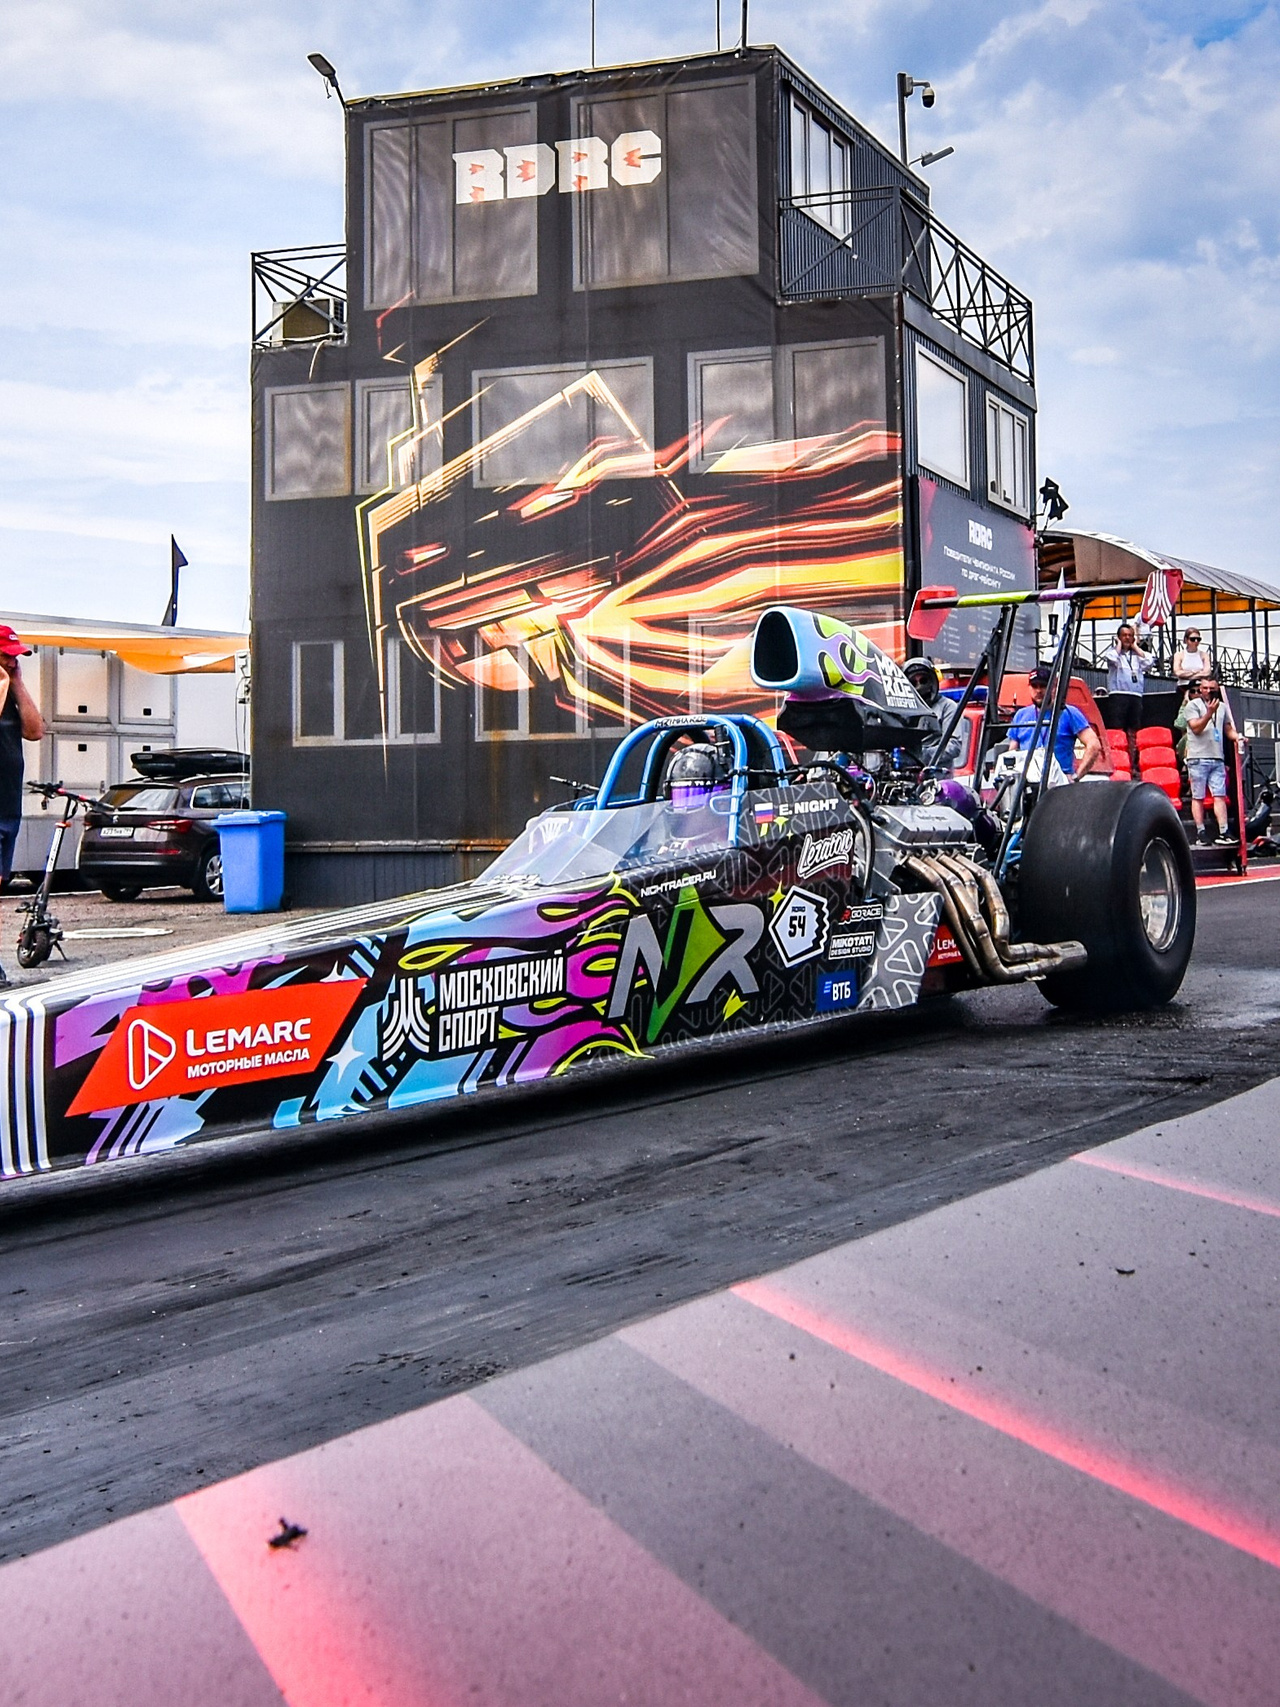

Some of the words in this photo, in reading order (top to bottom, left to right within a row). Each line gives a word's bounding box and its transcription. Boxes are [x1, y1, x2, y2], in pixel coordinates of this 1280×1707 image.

[452, 131, 662, 204] RDRC
[968, 519, 992, 550] RDRC
[778, 804, 793, 816] E.
[794, 798, 839, 815] NIGHT
[640, 869, 717, 898] NIGHTRACER.RU
[788, 915, 806, 938] 54
[830, 948, 850, 956] DESIGN
[852, 946, 872, 954] STUDIO
[832, 935, 873, 948] MIKOTATI
[936, 938, 957, 950] LEM
[438, 949, 565, 1011] МОСКОВСКИЙ
[832, 981, 851, 1002] ВТБ
[186, 1018, 312, 1057] LEMARC
[438, 1005, 500, 1052] СПОРТ
[187, 1056, 263, 1079] МОТОРНЫЕ
[265, 1048, 311, 1068] МАСЛА
